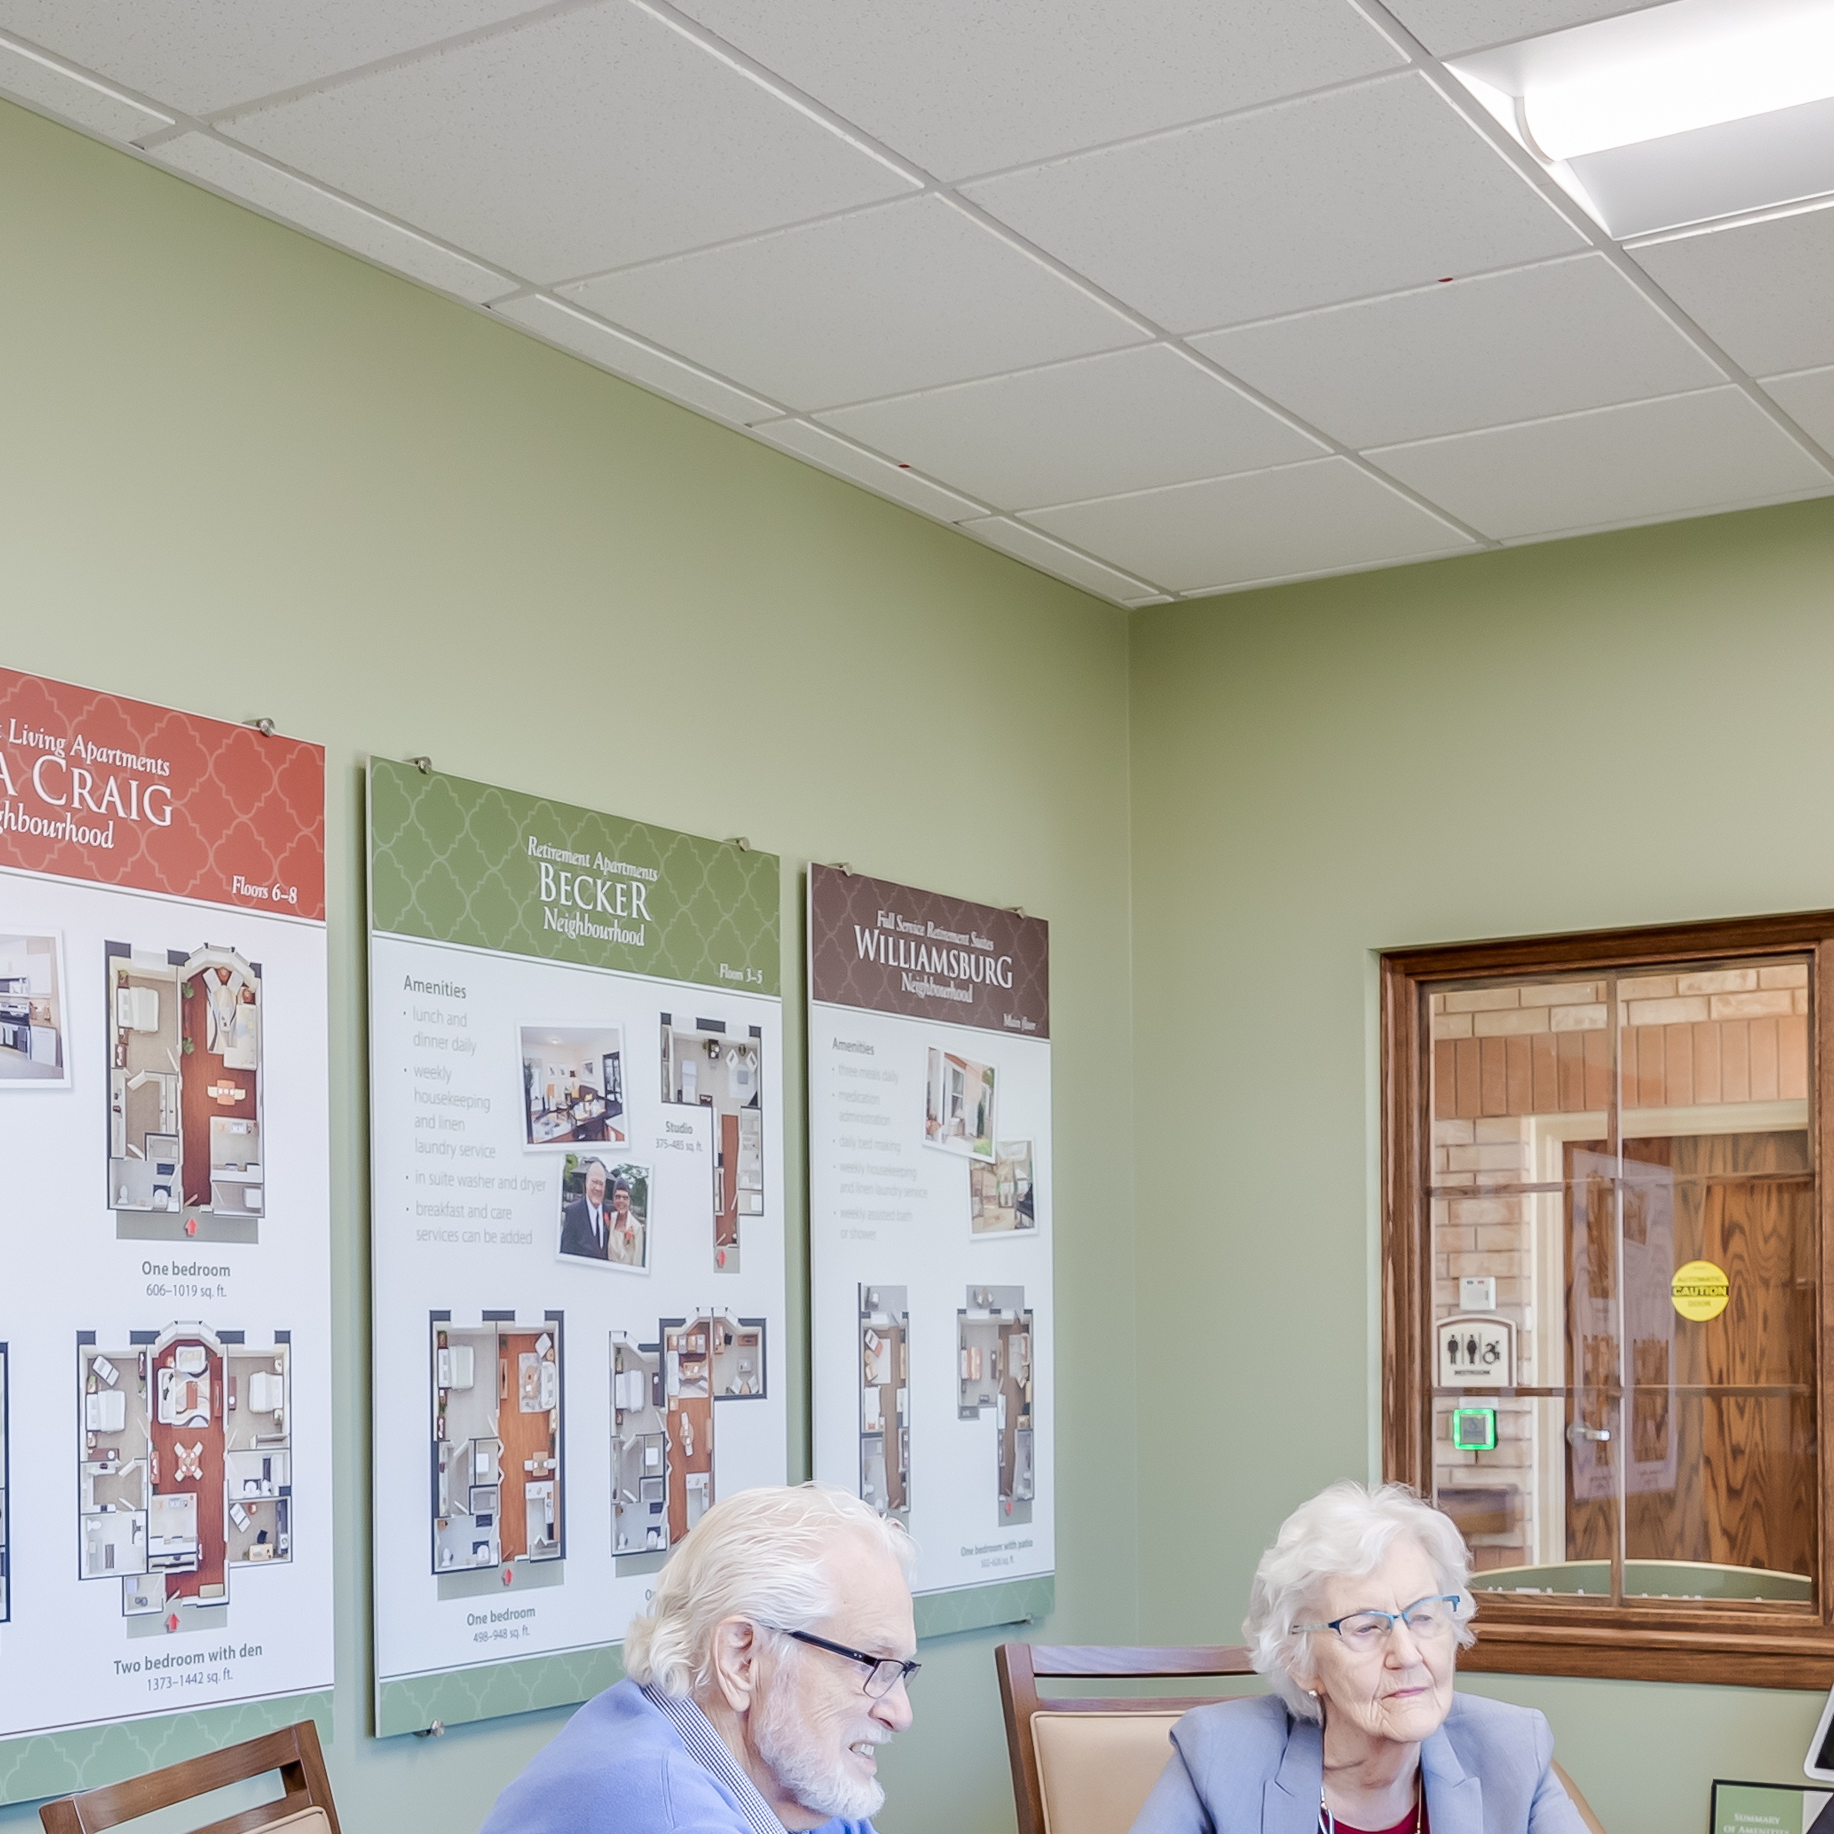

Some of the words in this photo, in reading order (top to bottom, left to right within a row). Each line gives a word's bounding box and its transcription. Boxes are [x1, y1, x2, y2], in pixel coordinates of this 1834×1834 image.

[9, 719, 66, 757] Living
[70, 734, 170, 776] Apartments
[33, 755, 172, 826] CRAIG
[528, 835, 590, 868] Retirement
[593, 852, 658, 882] Apartments
[232, 875, 268, 900] Floors
[272, 883, 297, 904] 6–8
[539, 861, 653, 921] BECKER
[543, 906, 645, 946] Neighbourhood
[854, 924, 1013, 989] WILLIAMSBURG
[720, 963, 743, 981] Floors
[746, 968, 763, 984] 3–5
[404, 975, 467, 999] Amenities
[901, 971, 973, 1004] Neighbourhood
[413, 1005, 444, 1024] lunch
[447, 1013, 467, 1027] and
[413, 1032, 449, 1050] dinner
[452, 1036, 476, 1056] daily
[832, 1037, 874, 1055] Amenities
[414, 1065, 452, 1084] weekly
[414, 1087, 491, 1114] housekeeping
[415, 1115, 435, 1129] and
[439, 1115, 465, 1131] linen
[415, 1137, 457, 1159] laundry
[460, 1145, 496, 1159] service
[416, 1170, 425, 1184] in
[429, 1171, 454, 1187] suite
[458, 1173, 495, 1188] washer
[498, 1175, 517, 1190] and
[520, 1177, 546, 1195] dryer
[416, 1200, 465, 1218] breakfast
[468, 1204, 488, 1219] and
[491, 1207, 512, 1220] care
[417, 1227, 459, 1243] services
[462, 1231, 480, 1243] can
[484, 1229, 497, 1244] be
[500, 1230, 533, 1244] added
[142, 1261, 168, 1275] One
[172, 1261, 230, 1276] bedroom
[1673, 1287, 1727, 1296] CAUTION
[467, 1613, 488, 1626] One
[490, 1608, 536, 1623] bedroom
[114, 1660, 141, 1674] Two
[145, 1653, 205, 1671] bedroom
[208, 1645, 236, 1661] with
[239, 1643, 262, 1658] den
[147, 1672, 204, 1691] 1373–1442
[207, 1672, 221, 1684] sq.
[223, 1667, 233, 1681] ft.
